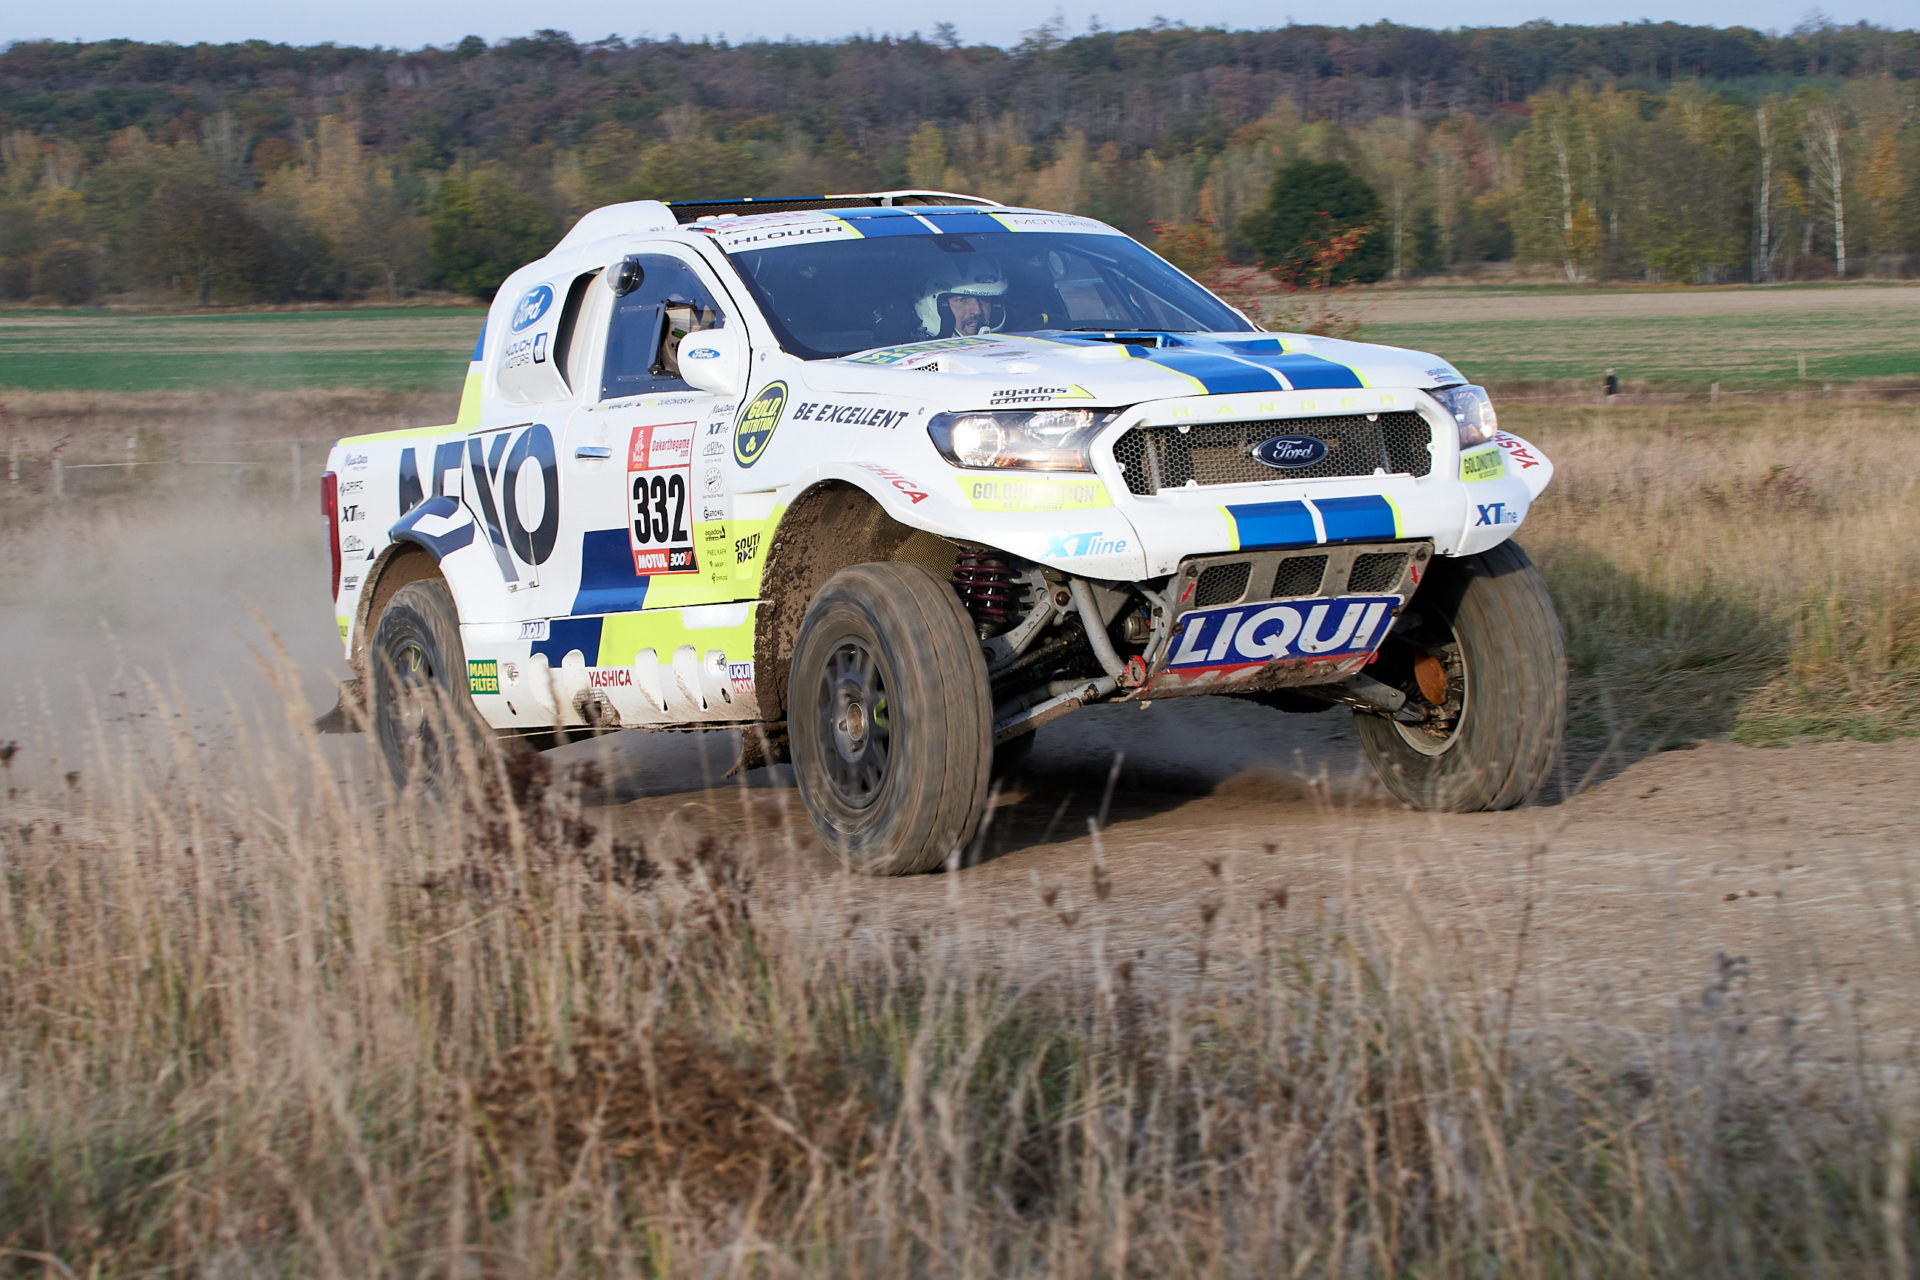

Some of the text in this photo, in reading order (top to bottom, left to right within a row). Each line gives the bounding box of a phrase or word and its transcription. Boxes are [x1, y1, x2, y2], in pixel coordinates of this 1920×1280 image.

[733, 226, 842, 245] HLOUCH
[513, 289, 546, 329] Ford
[992, 387, 1068, 398] agados
[747, 396, 783, 420] GOLD
[792, 402, 910, 430] BE EXCELLENT
[1173, 394, 1395, 418] RANGER
[1272, 439, 1314, 460] Ford
[972, 482, 1096, 504] GOLDNUTRITION
[632, 473, 689, 545] 332
[1038, 531, 1127, 561] XTline
[637, 553, 668, 570] MOTUL
[669, 550, 693, 567] 300V
[1169, 602, 1389, 666] LIQUI
[469, 663, 497, 677] MANN
[588, 669, 633, 688] YASHICA
[729, 664, 751, 679] LIQUI
[470, 677, 499, 692] FILTER
[731, 679, 755, 694] MOLY
